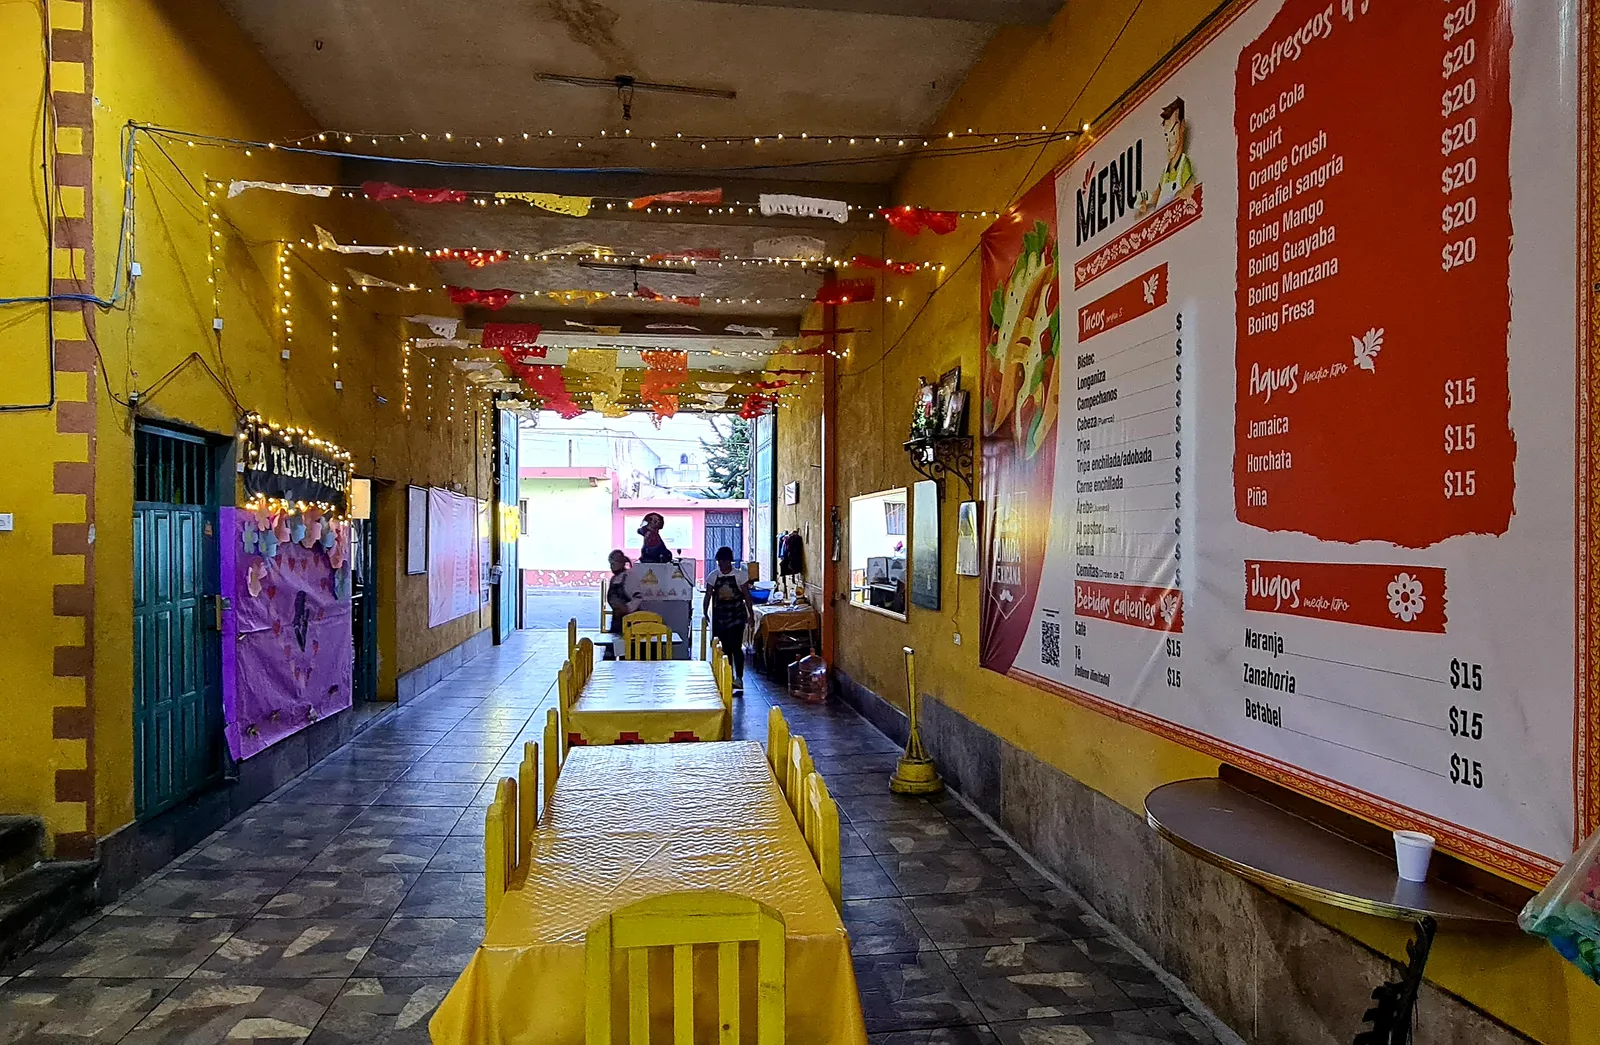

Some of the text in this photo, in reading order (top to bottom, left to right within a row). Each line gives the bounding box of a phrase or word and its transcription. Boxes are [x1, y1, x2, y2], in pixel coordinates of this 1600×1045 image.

[1251, 4, 1333, 86] Refrescos
[1249, 0, 1476, 162] Squirt $20
[1249, 83, 1305, 133] Coca Cola
[1249, 38, 1475, 191] Orange Crush $20
[1248, 78, 1476, 220] Peñafiel sangría $20
[1076, 138, 1143, 247] MENU
[1248, 117, 1477, 249] Boing Mango $20
[1248, 157, 1477, 278] Boing Guayaba $20
[1248, 196, 1477, 307] Boing Manzana $20
[1248, 236, 1476, 336] Boing Fresa $20
[1081, 309, 1105, 333] Tacos
[1077, 352, 1095, 370] Bistec
[1077, 369, 1106, 391] Longaniza
[1249, 362, 1299, 404] Aguas
[1077, 388, 1118, 411] Campechanos
[1077, 416, 1097, 432] Cabeza
[1247, 377, 1476, 439] Jamaica $15
[1076, 459, 1090, 475] Tripa
[1077, 439, 1090, 454] Tripa
[1247, 423, 1476, 473] Horchata $15
[1076, 480, 1093, 494] Carne
[1093, 475, 1124, 490] enchilada
[1247, 469, 1476, 507] Piña $15
[1076, 562, 1099, 578] Cemitas
[1251, 563, 1300, 611] Jugos
[1076, 585, 1156, 626] Bebidas calientes
[1166, 637, 1181, 658] $15
[1245, 627, 1482, 691] Naranja $15
[1167, 667, 1181, 688] $15
[1243, 663, 1483, 741] Zanahoria $15
[1245, 698, 1483, 789] Betabel $15
